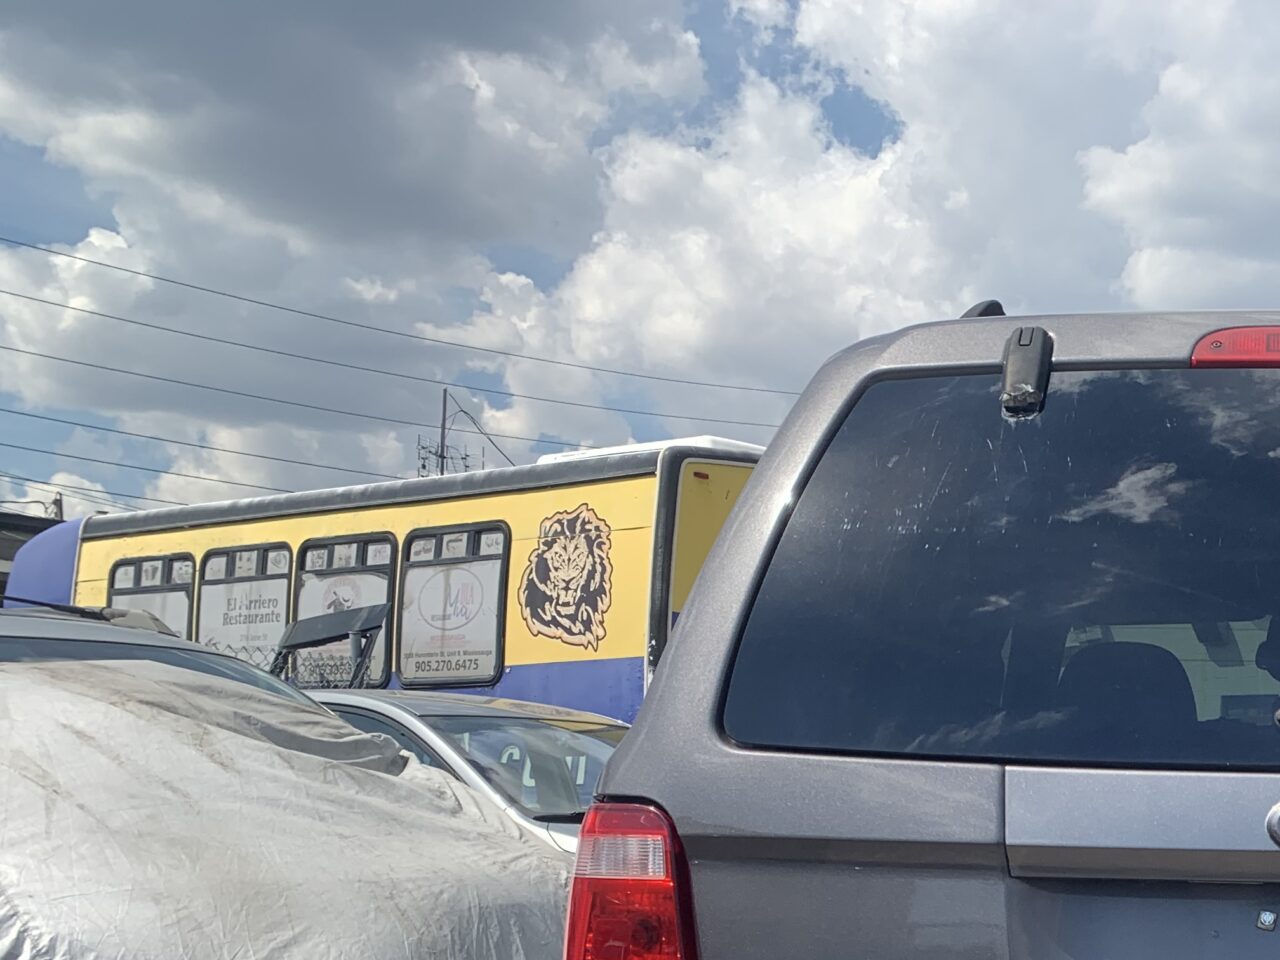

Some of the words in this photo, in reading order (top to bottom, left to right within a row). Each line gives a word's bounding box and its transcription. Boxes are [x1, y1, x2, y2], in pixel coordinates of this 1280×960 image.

[227, 598, 237, 611] El
[223, 611, 281, 626] Restaurante
[415, 659, 479, 672] 905.270.6475
